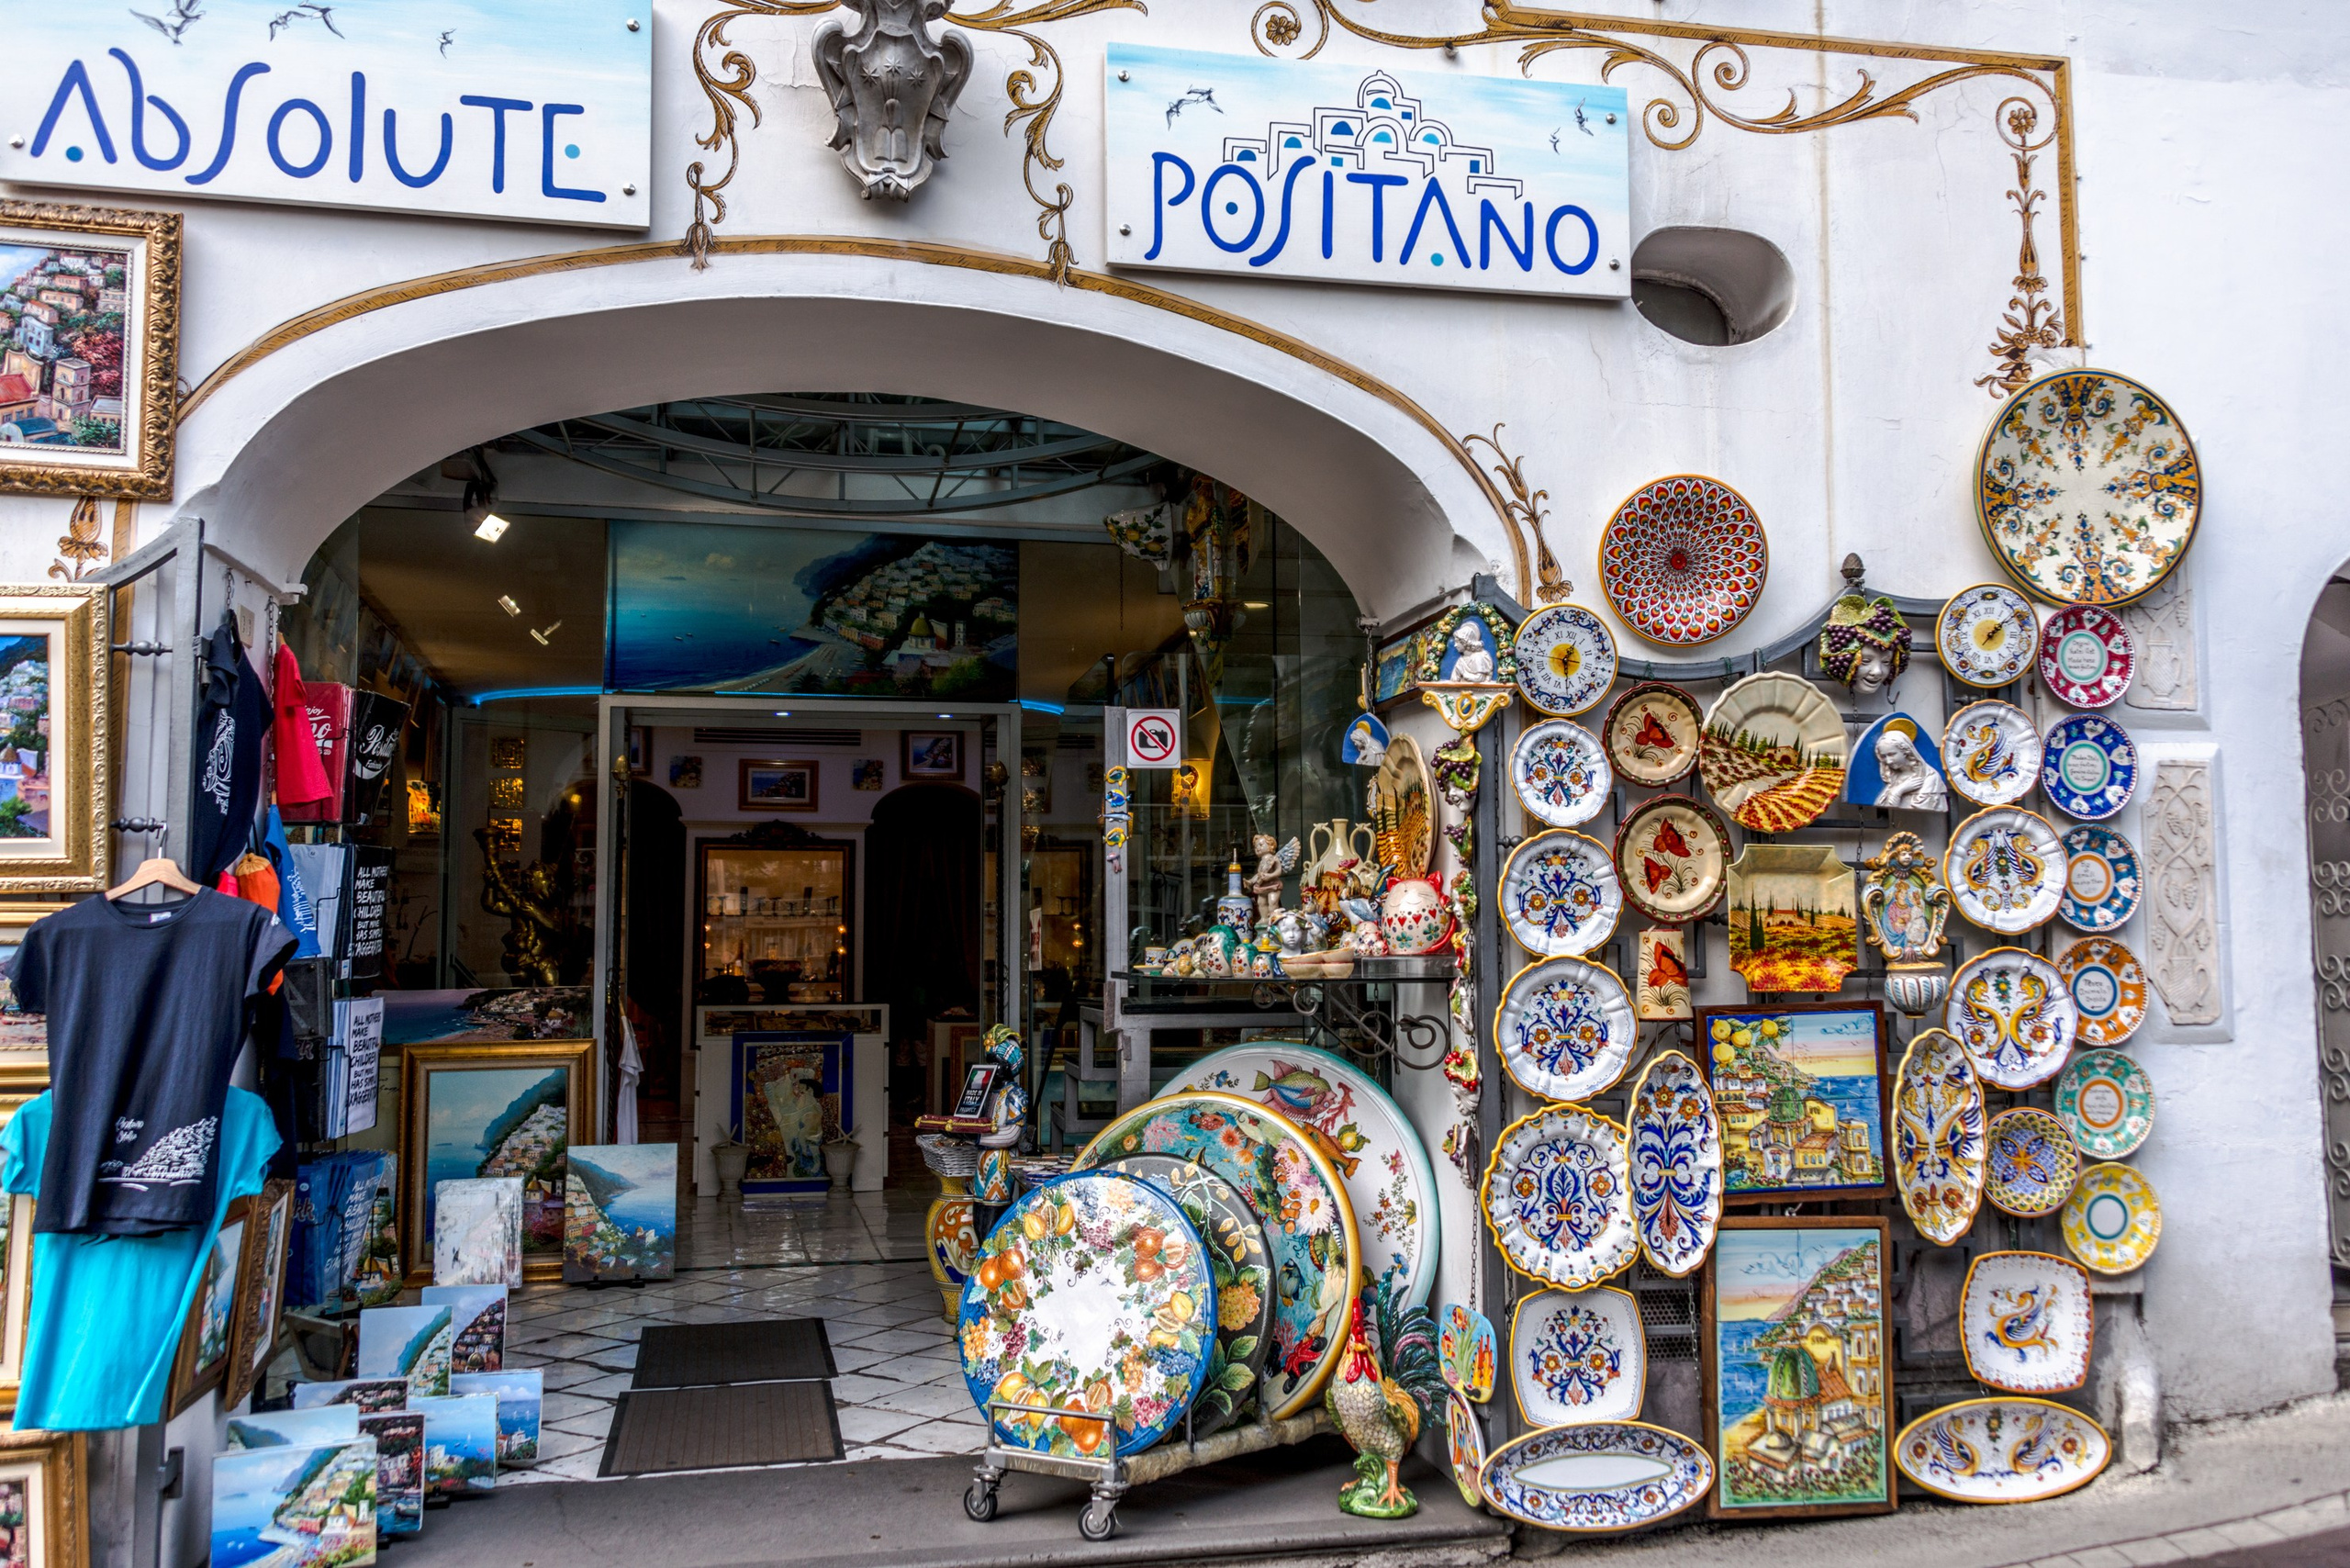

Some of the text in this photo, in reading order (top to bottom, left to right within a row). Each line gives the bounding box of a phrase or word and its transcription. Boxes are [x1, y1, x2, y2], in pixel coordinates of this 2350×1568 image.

[1145, 151, 1599, 275] POSITANO
[305, 705, 324, 716] njoy
[357, 867, 371, 878] ALL
[354, 879, 375, 890] MAKE
[353, 1015, 364, 1026] ALL
[352, 1026, 368, 1038] MAKE
[353, 1070, 364, 1079] BUT
[351, 1079, 364, 1090] HAS
[963, 1096, 980, 1104] ITALY
